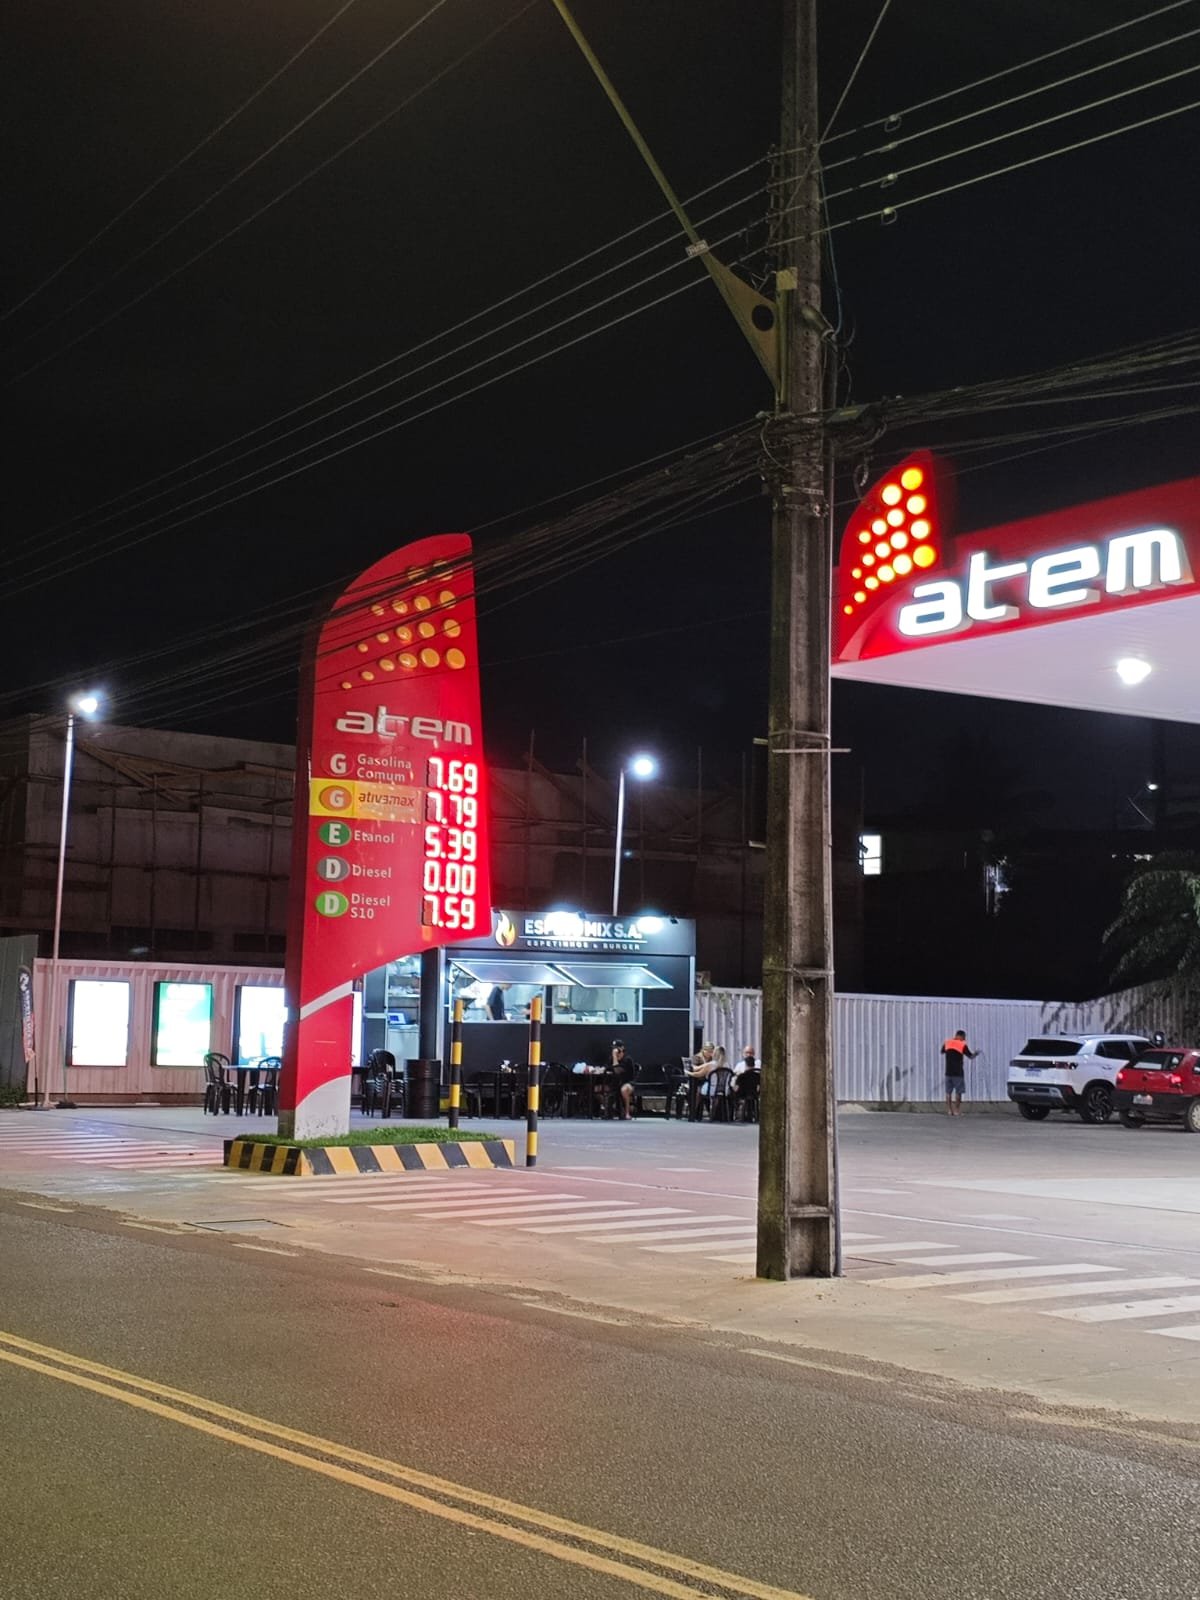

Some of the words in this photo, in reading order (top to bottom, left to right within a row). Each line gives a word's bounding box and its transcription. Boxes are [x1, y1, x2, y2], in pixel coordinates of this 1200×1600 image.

[897, 529, 1186, 637] atem
[336, 705, 473, 746] atem
[330, 753, 347, 775] G
[356, 753, 412, 770] Gasolina
[356, 767, 406, 783] Comum
[427, 757, 478, 795] 7.69
[329, 789, 346, 809] G
[426, 791, 478, 829] 7.79
[328, 823, 342, 844] E
[354, 830, 395, 844] Etanol
[424, 826, 477, 862] 5.39
[326, 858, 342, 879] D
[352, 863, 392, 878] Diesel
[424, 859, 476, 896] 0.00
[324, 893, 340, 914] D
[351, 893, 391, 907] Diesel
[350, 906, 374, 919] S10
[424, 895, 476, 931] 7.59
[584, 921, 612, 938] MIX
[603, 943, 640, 951] BURGER
